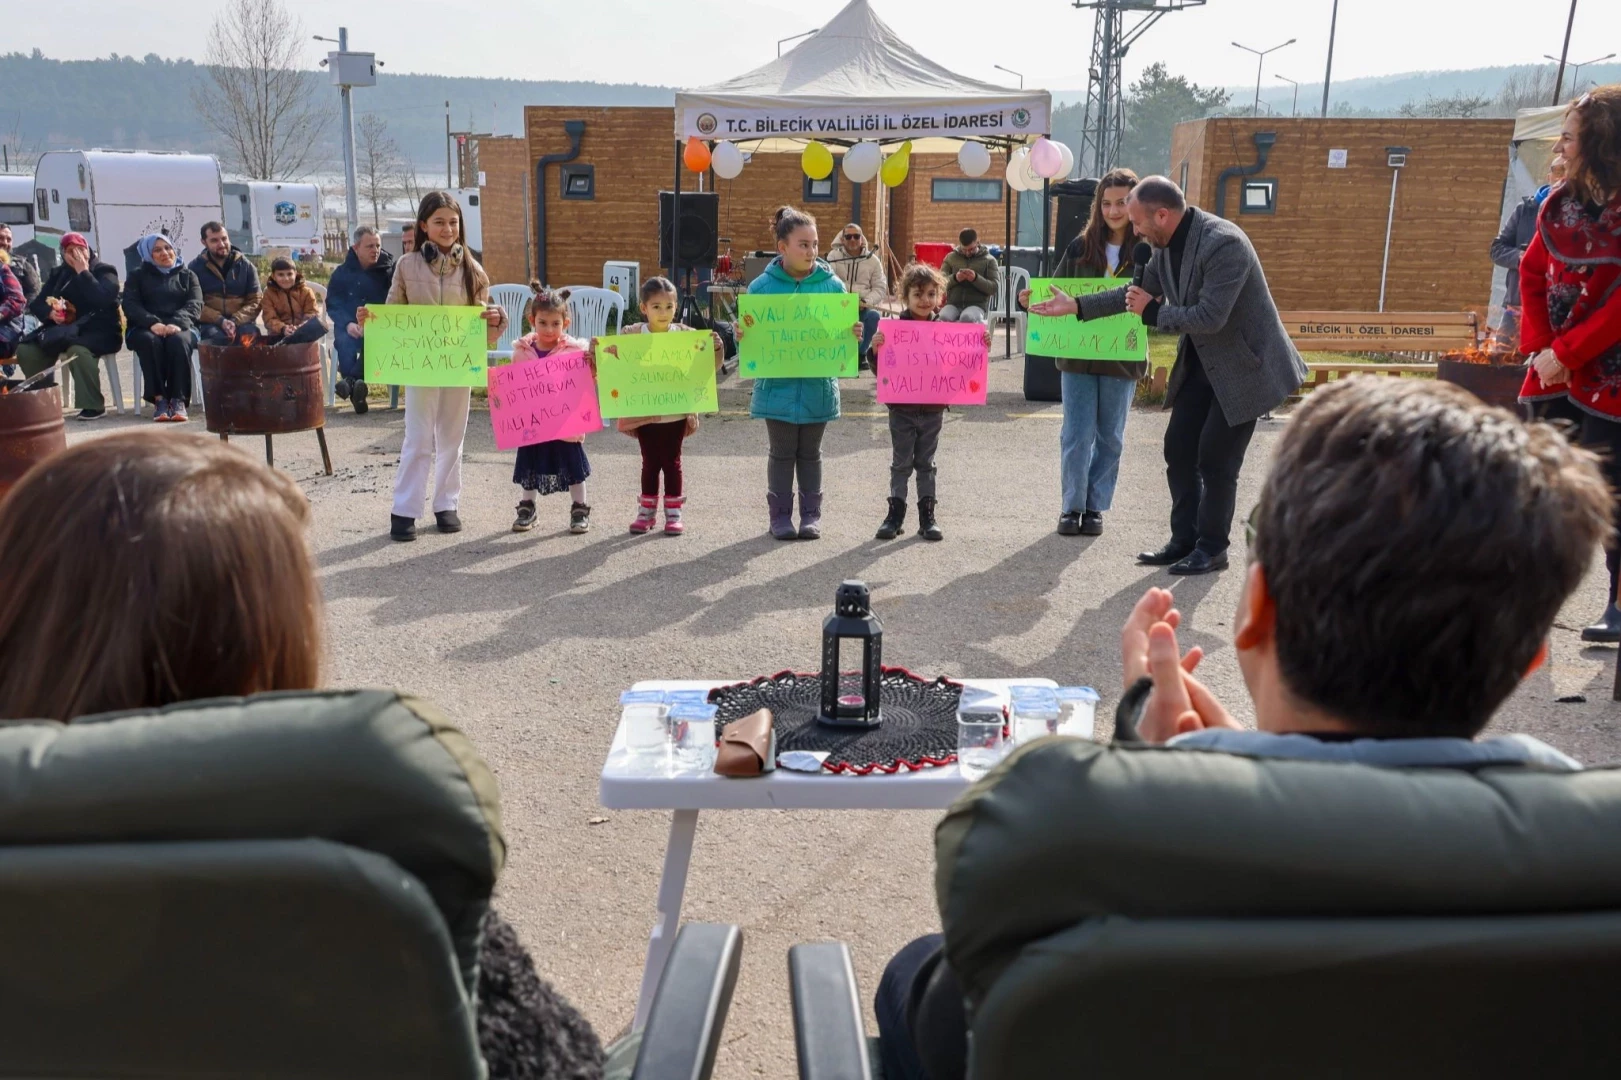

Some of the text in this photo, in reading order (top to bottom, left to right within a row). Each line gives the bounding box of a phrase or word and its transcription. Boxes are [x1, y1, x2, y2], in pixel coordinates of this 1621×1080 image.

[726, 119, 751, 132] T.C.
[755, 116, 813, 133] BİLECİK
[816, 114, 879, 132] VALİLİĞİ
[884, 113, 898, 130] İL
[902, 113, 939, 130] ÖZEL
[944, 111, 1003, 129] İDARESİ
[610, 275, 619, 285] 43
[752, 304, 830, 324] VALİ AMCA
[380, 312, 466, 336] SENİ ÇOK
[1300, 324, 1435, 335] BİLECİK İL ÖZEL İDARESİ
[392, 335, 469, 351] SEVİYORUZ
[893, 329, 920, 345] BEN
[1079, 334, 1119, 354] AMCA
[376, 351, 473, 370] VALİ AMCA
[661, 349, 692, 362] AMCA
[889, 370, 967, 394] VALİ AMCA
[531, 403, 571, 427] AMCA
